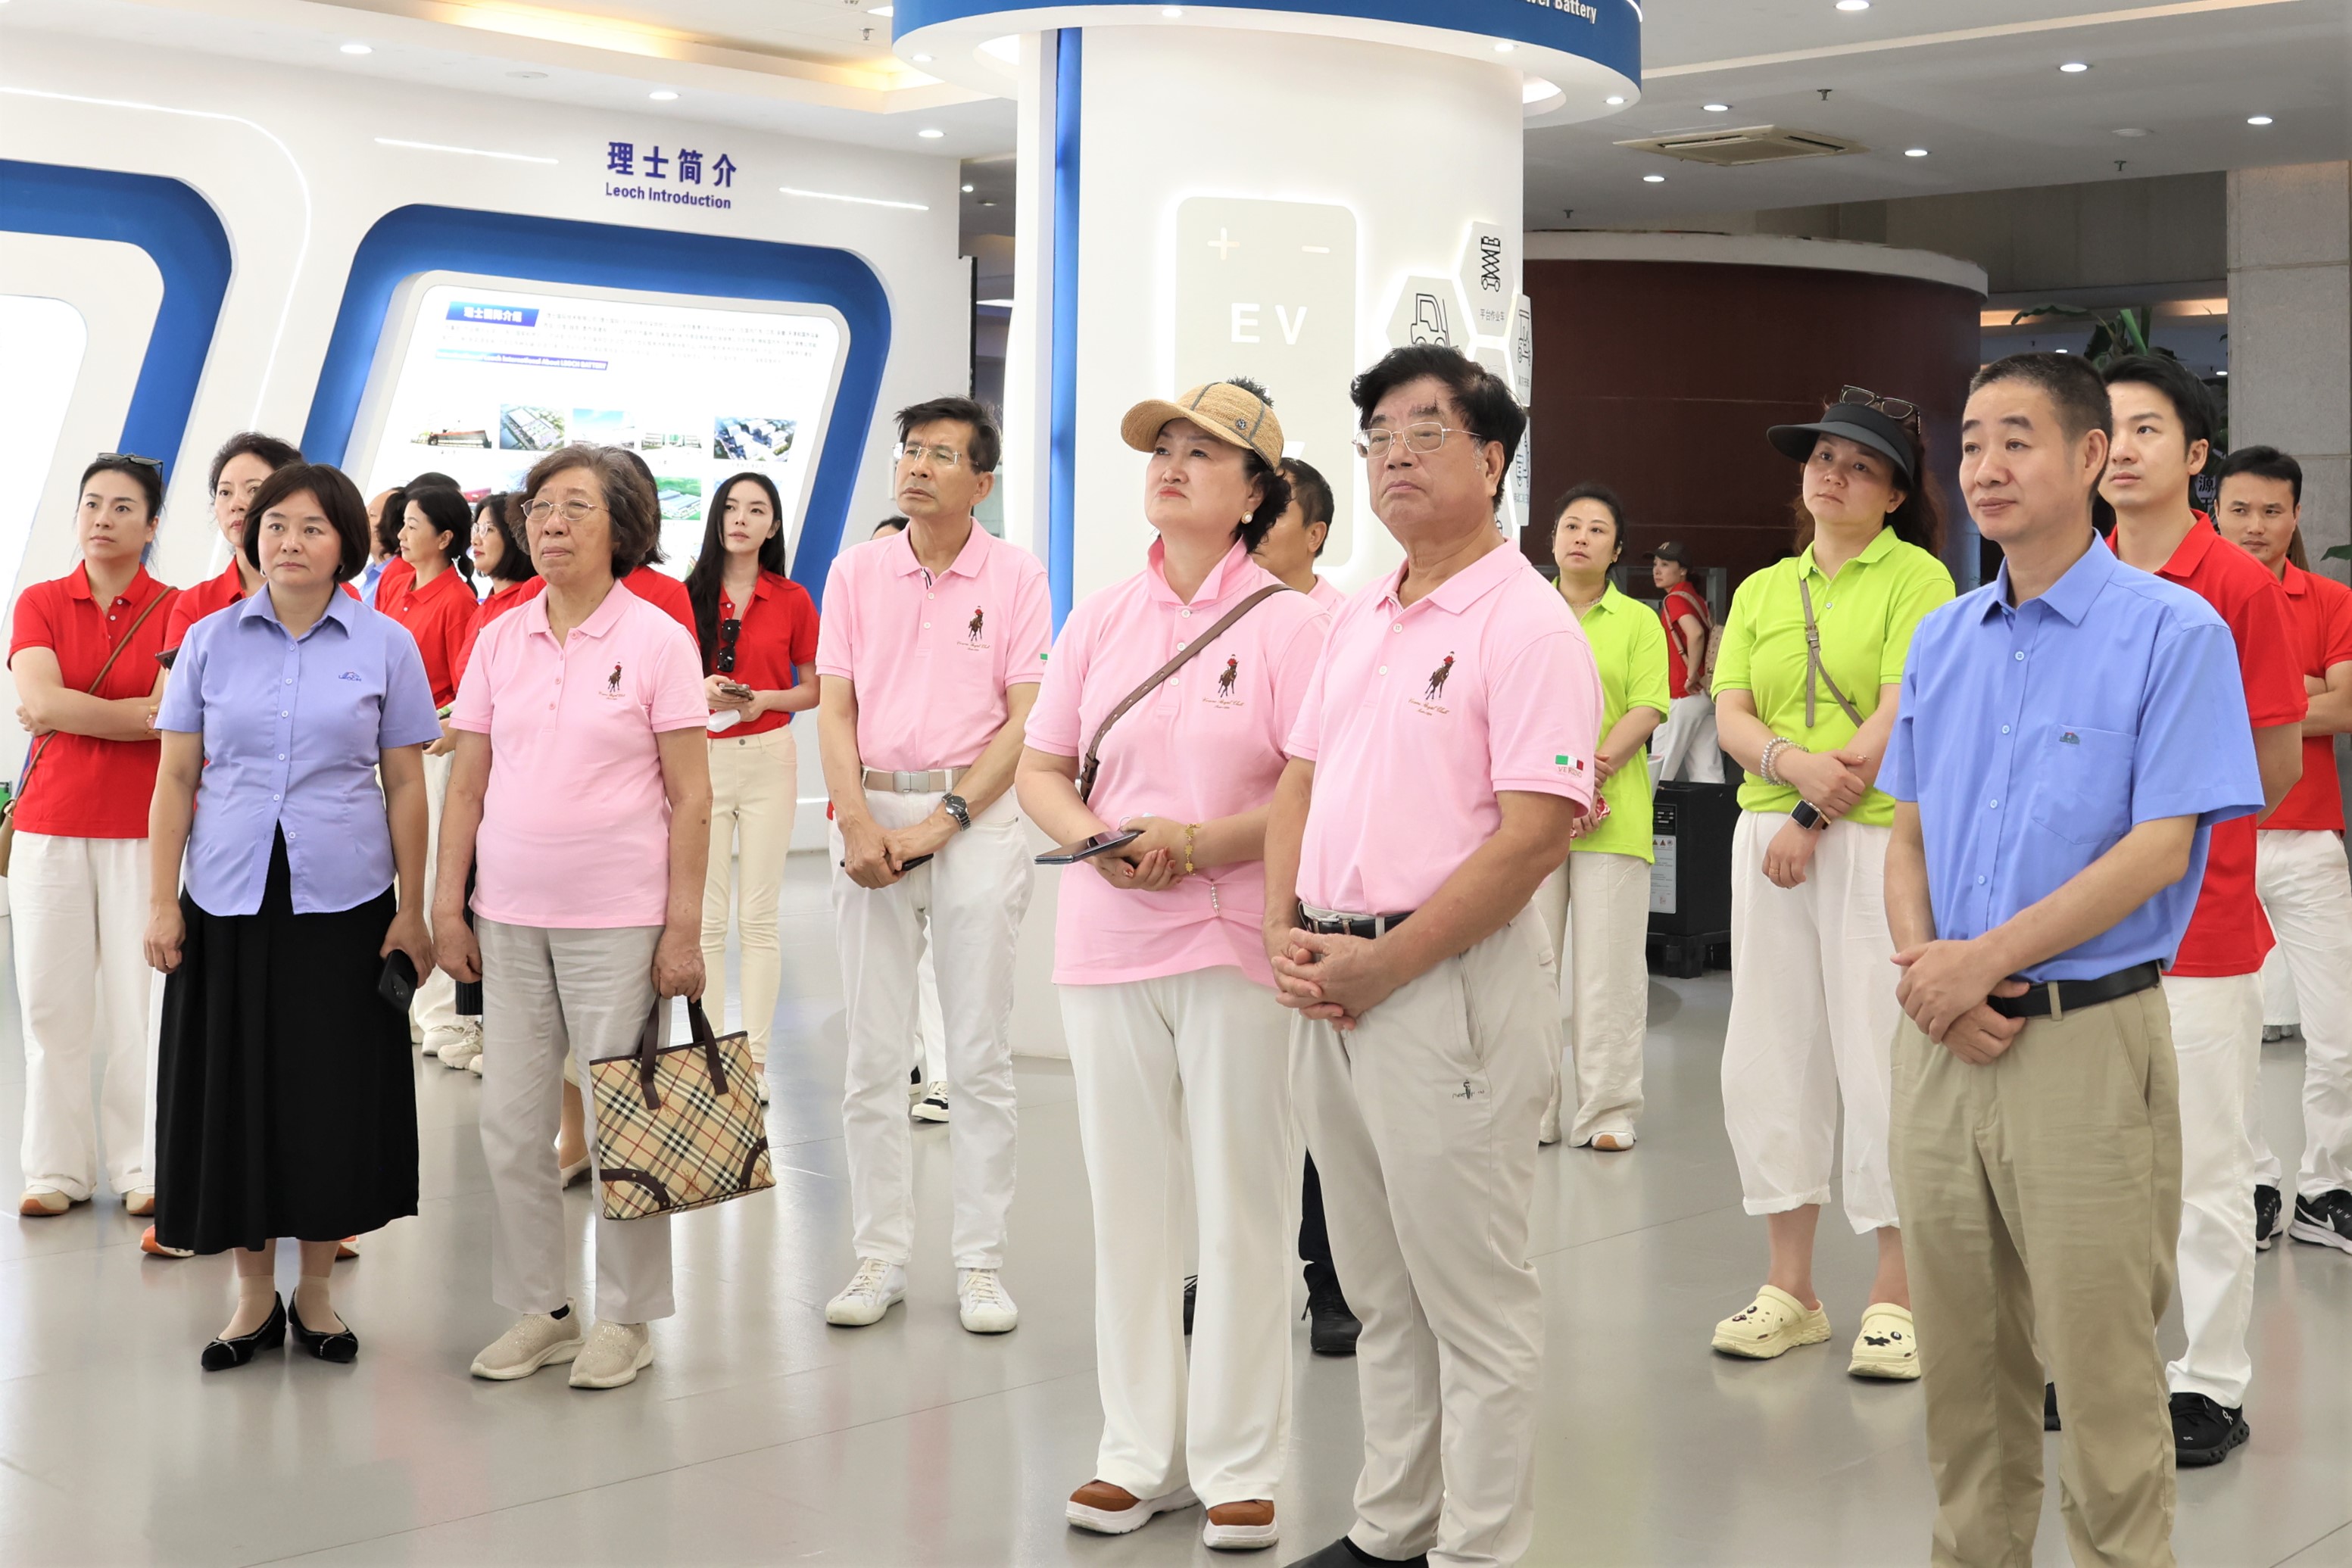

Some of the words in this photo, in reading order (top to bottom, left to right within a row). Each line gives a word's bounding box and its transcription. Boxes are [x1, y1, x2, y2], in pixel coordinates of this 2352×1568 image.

[1554, 0, 1597, 24] Battery
[607, 142, 737, 188] 理士简介
[606, 182, 644, 200] Leoch
[649, 187, 731, 209] Introduction
[1231, 302, 1308, 345] EV
